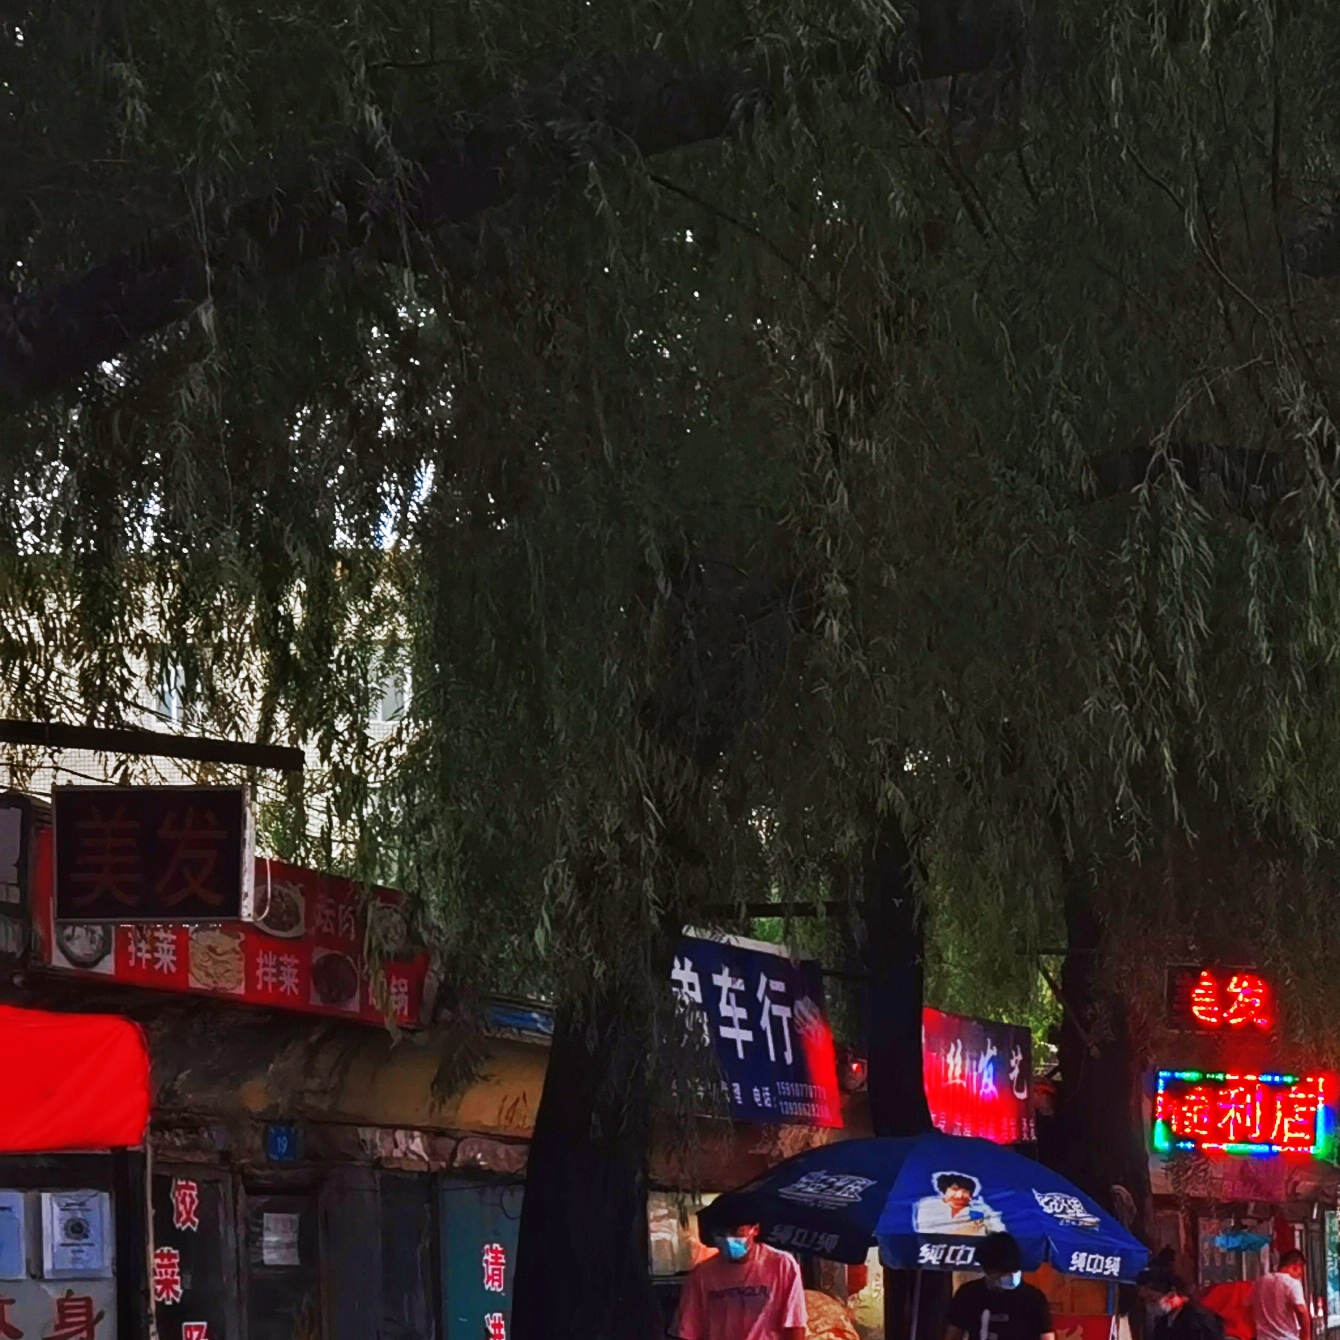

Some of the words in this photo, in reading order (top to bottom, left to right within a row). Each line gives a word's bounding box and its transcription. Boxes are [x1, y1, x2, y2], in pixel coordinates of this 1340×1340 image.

[70, 805, 229, 908] 美发
[128, 928, 177, 975] 拌菜
[256, 948, 300, 997] 拌菜
[1167, 1084, 1311, 1142] 便利店
[918, 1243, 981, 1266] 纯中
[1068, 1251, 1122, 1277] 纯中纯
